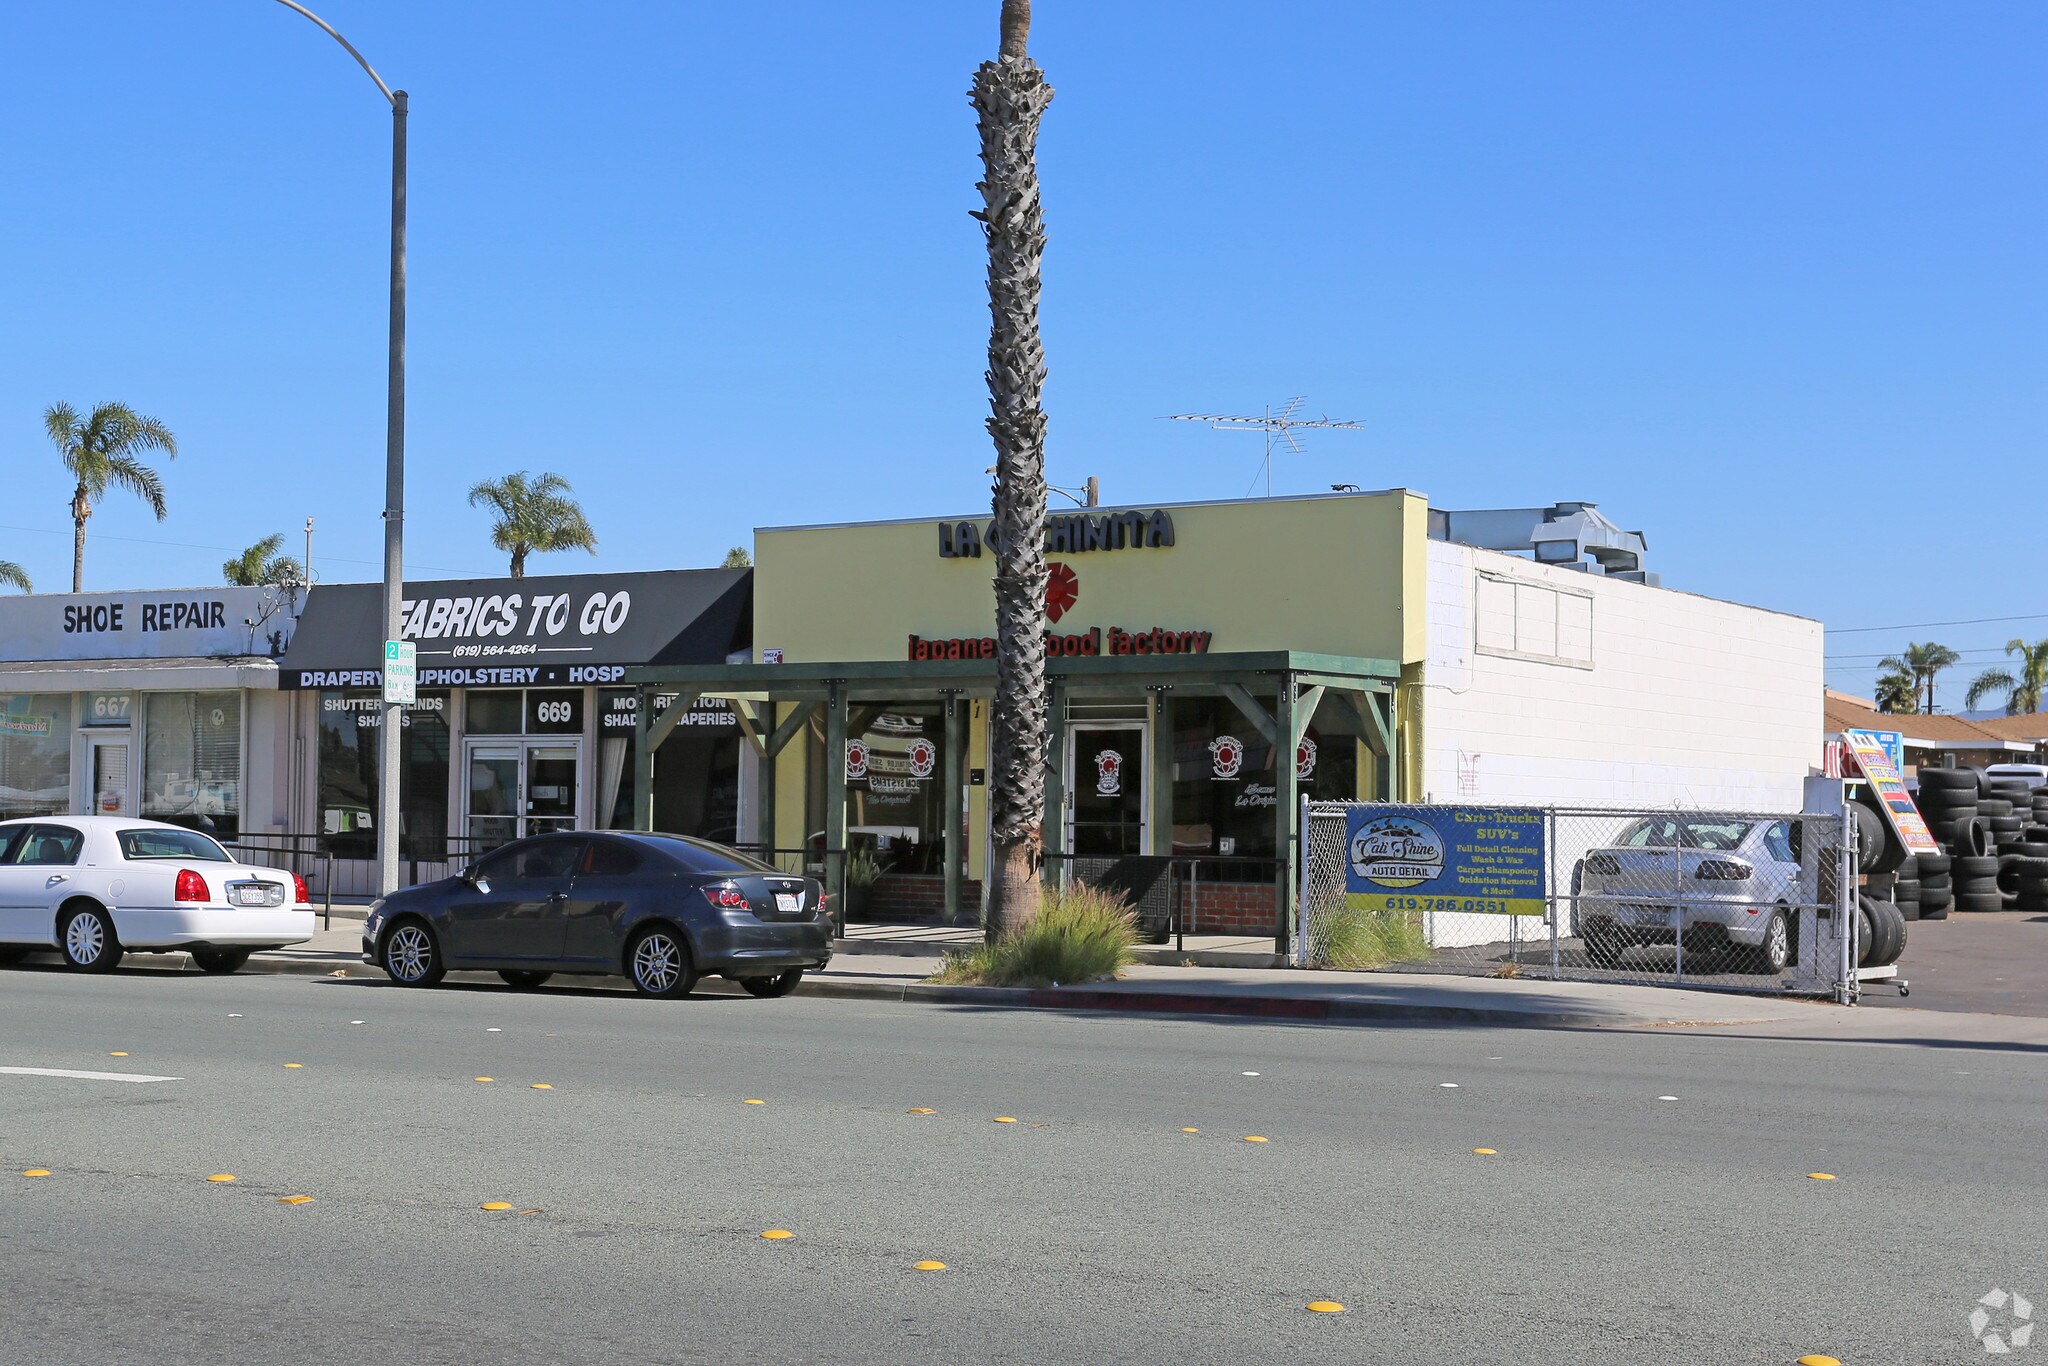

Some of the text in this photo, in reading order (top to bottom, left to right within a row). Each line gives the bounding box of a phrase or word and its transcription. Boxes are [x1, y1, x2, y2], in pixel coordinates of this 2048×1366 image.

[938, 521, 981, 558] LA
[63, 601, 226, 634] SHOE REPAIR
[526, 592, 571, 637] TO
[579, 590, 631, 636] GO
[1045, 626, 1101, 658] ood
[1107, 626, 1213, 656] factory
[389, 644, 396, 658] 2
[452, 642, 538, 658] (619) 564-4264
[387, 664, 414, 677] PARKING
[300, 671, 383, 687] DRAPERY
[94, 696, 130, 718] 667
[324, 699, 382, 711] SHUTTER
[537, 701, 572, 723] 669
[357, 715, 410, 728] SHAS
[1455, 812, 1540, 824] Cars Trucks
[1476, 828, 1519, 840] SUV's
[1356, 837, 1437, 859] Cali Shine
[1456, 844, 1539, 855] Full Detail Cleaning
[1471, 855, 1495, 863] Wash
[1505, 856, 1524, 864] Wax
[1371, 866, 1430, 876] AUTO DETAIL
[1456, 865, 1539, 876] Carpet Shampooing
[1458, 876, 1538, 885] Oxidation Removal
[1490, 887, 1514, 895] More!
[1385, 897, 1508, 913] 619.786.0551
